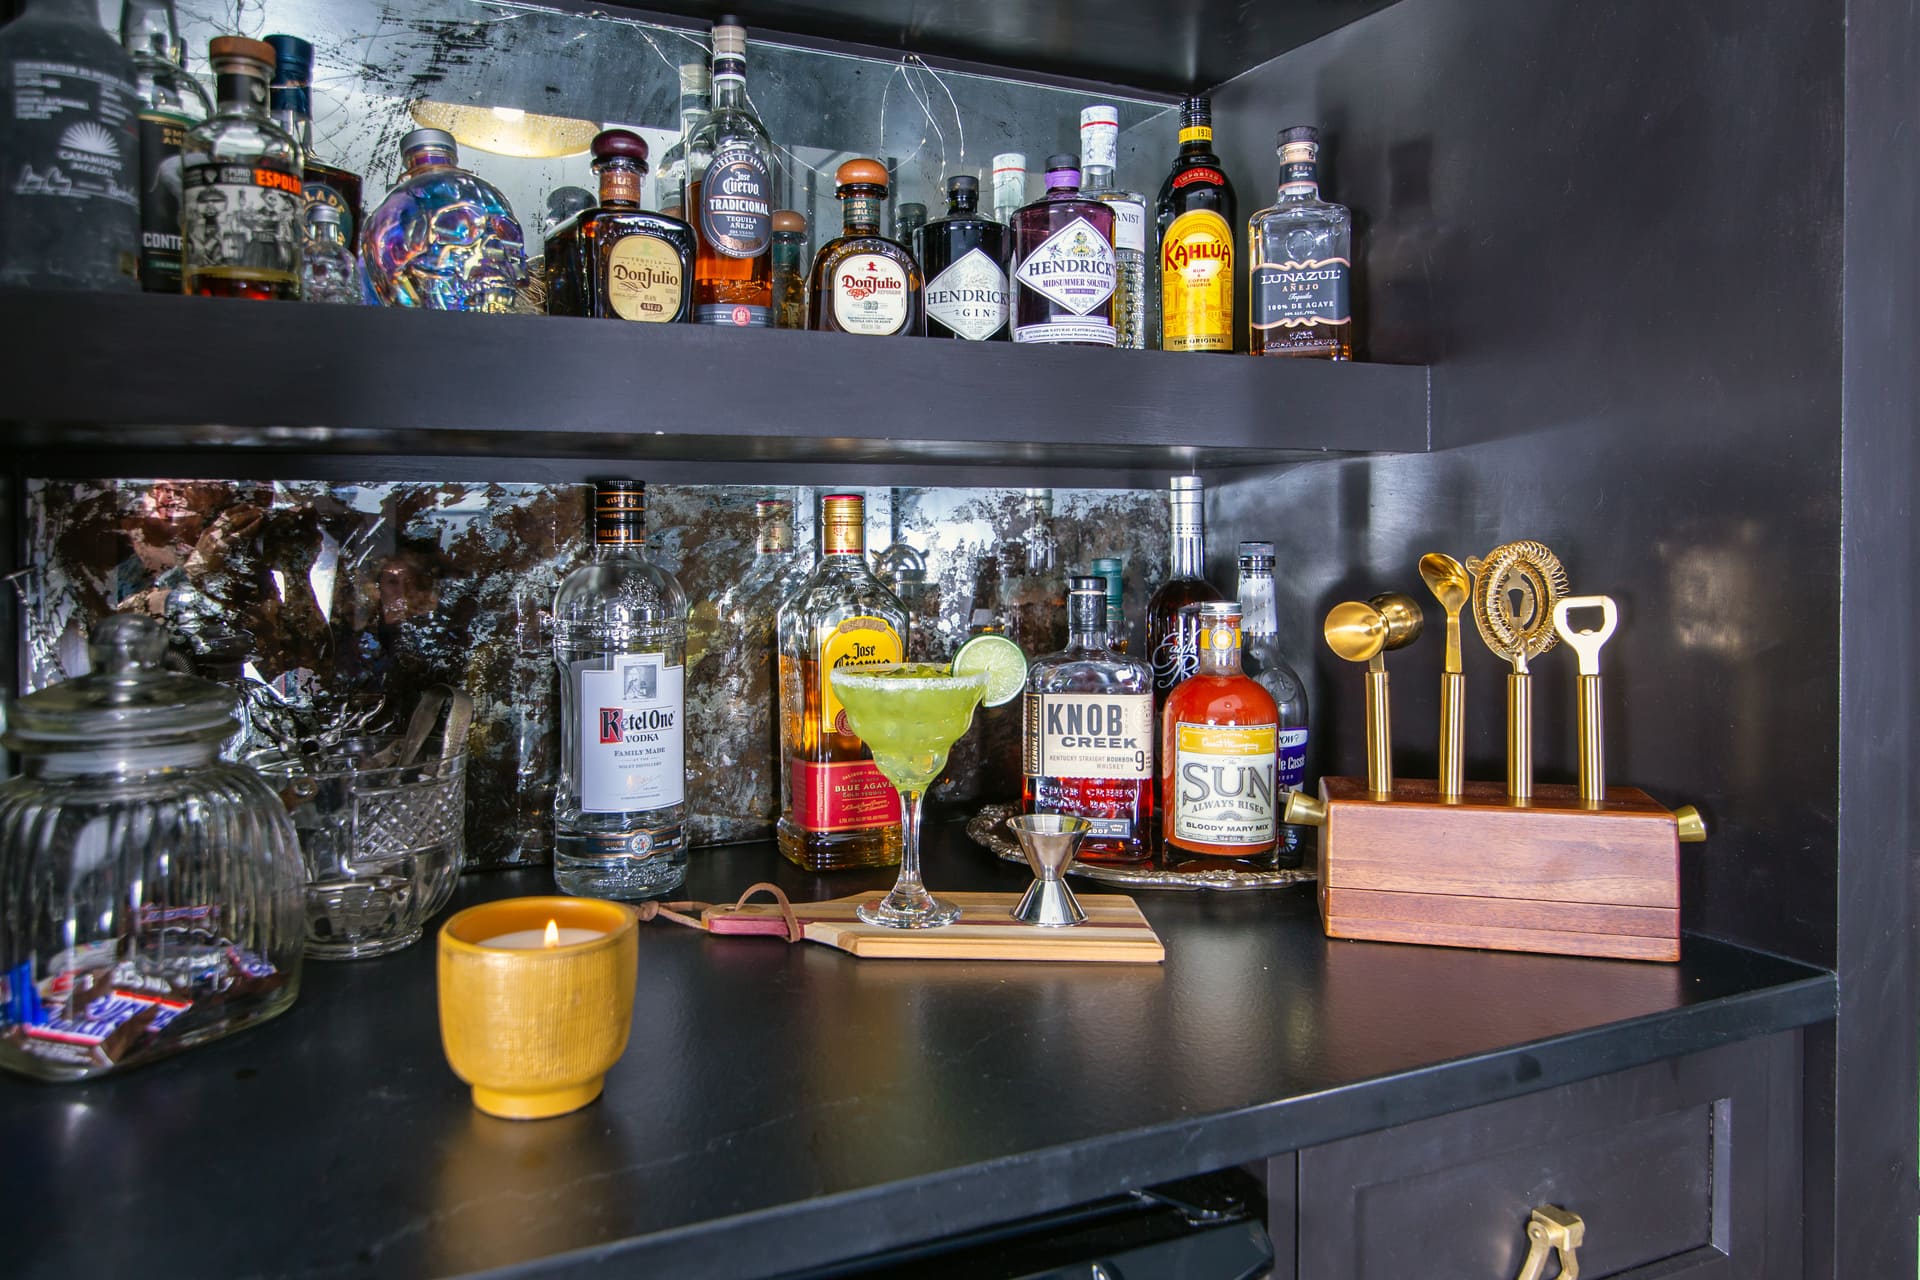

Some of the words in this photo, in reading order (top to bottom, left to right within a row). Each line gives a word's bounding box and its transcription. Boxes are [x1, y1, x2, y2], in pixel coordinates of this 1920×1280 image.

[722, 176, 760, 195] Cuervo
[709, 199, 769, 216] TRADICIONAL
[726, 215, 758, 225] TEQUILA
[729, 222, 755, 230] AÑEJO
[1164, 239, 1231, 272] KAHLÚA
[1260, 270, 1340, 285] LUNAZUL
[1042, 279, 1085, 288] MIDSUMMER
[1282, 283, 1319, 292] AÑEJO
[1268, 303, 1288, 311] 100%
[962, 308, 991, 318] GIN
[852, 643, 876, 660] Jose
[602, 709, 647, 741] Ketel
[648, 709, 674, 729] One
[1047, 703, 1122, 737] KNOB
[625, 733, 660, 743] VODKA
[1061, 736, 1138, 749] CREEK
[614, 749, 644, 757] FAMILY
[645, 747, 666, 755] MADE
[1106, 755, 1134, 763] BOURBON
[835, 784, 861, 792] BLUE
[1183, 763, 1272, 809] SUN
[1191, 800, 1234, 813] ALWAYS
[1237, 800, 1265, 815] RISES
[1186, 821, 1224, 832] BLOODY
